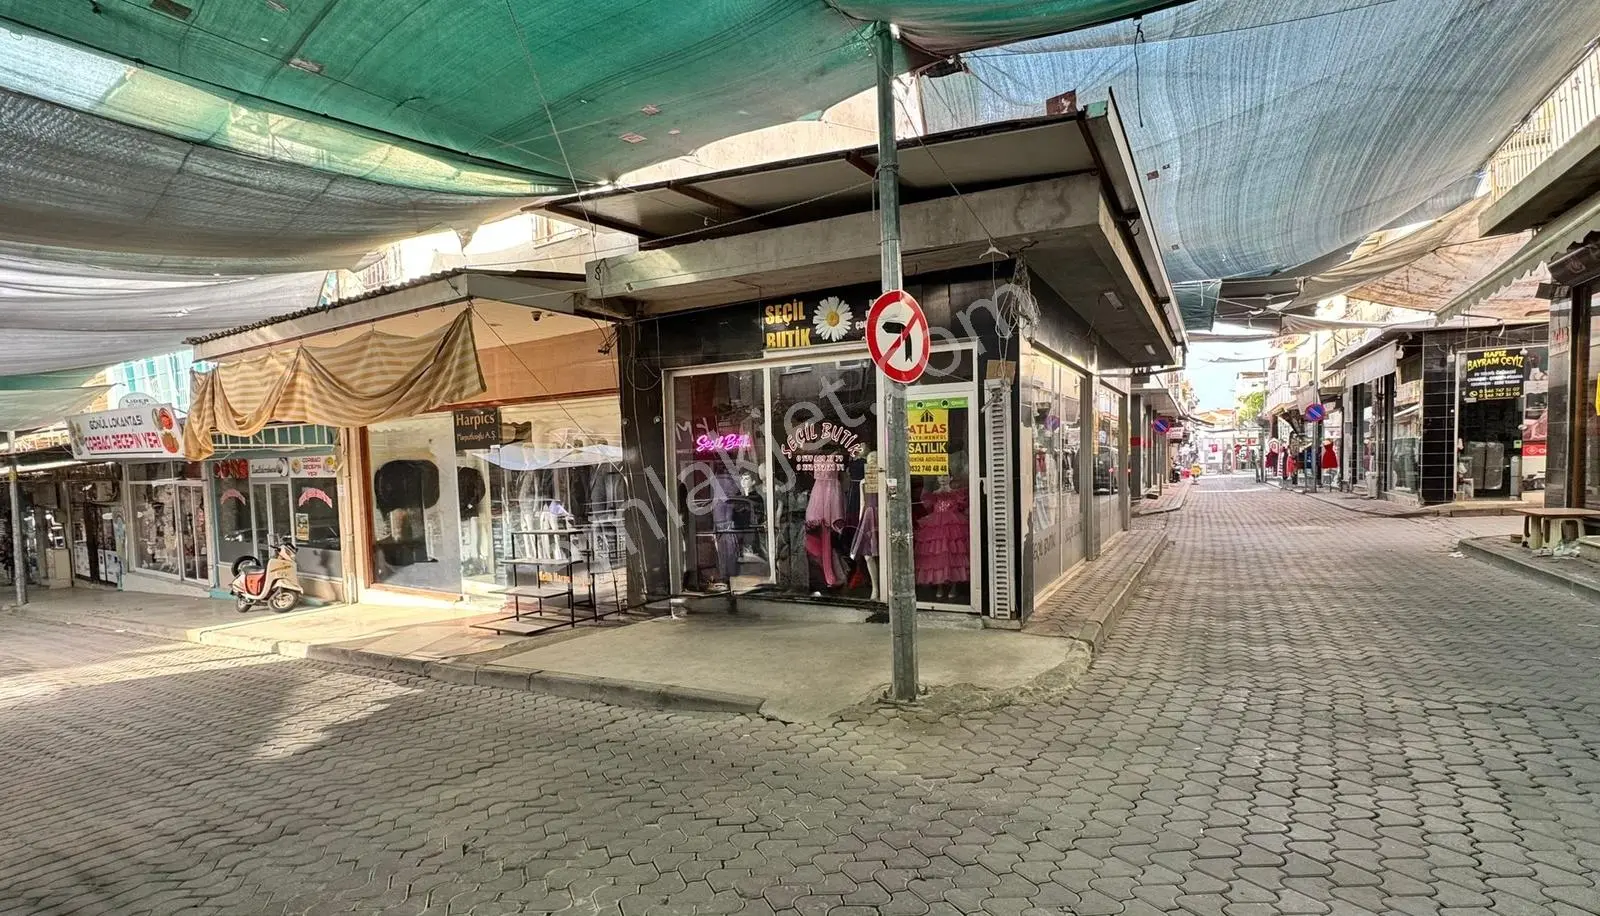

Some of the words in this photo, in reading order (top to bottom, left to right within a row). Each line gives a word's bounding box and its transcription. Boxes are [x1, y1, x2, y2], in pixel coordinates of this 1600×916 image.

[765, 299, 806, 327] SEÇİL
[766, 326, 811, 349] BUTİK
[1467, 357, 1500, 371] BAYRAM
[1500, 354, 1524, 368] ÇEYİZ
[89, 416, 109, 430] GÖNÜL
[109, 414, 144, 428] LOKANTASI
[456, 413, 495, 430] Harpics
[909, 424, 947, 435] ATLAS
[781, 422, 818, 460] SEÇİL
[820, 422, 864, 458] BUTİK
[908, 442, 947, 453] SATILIK
